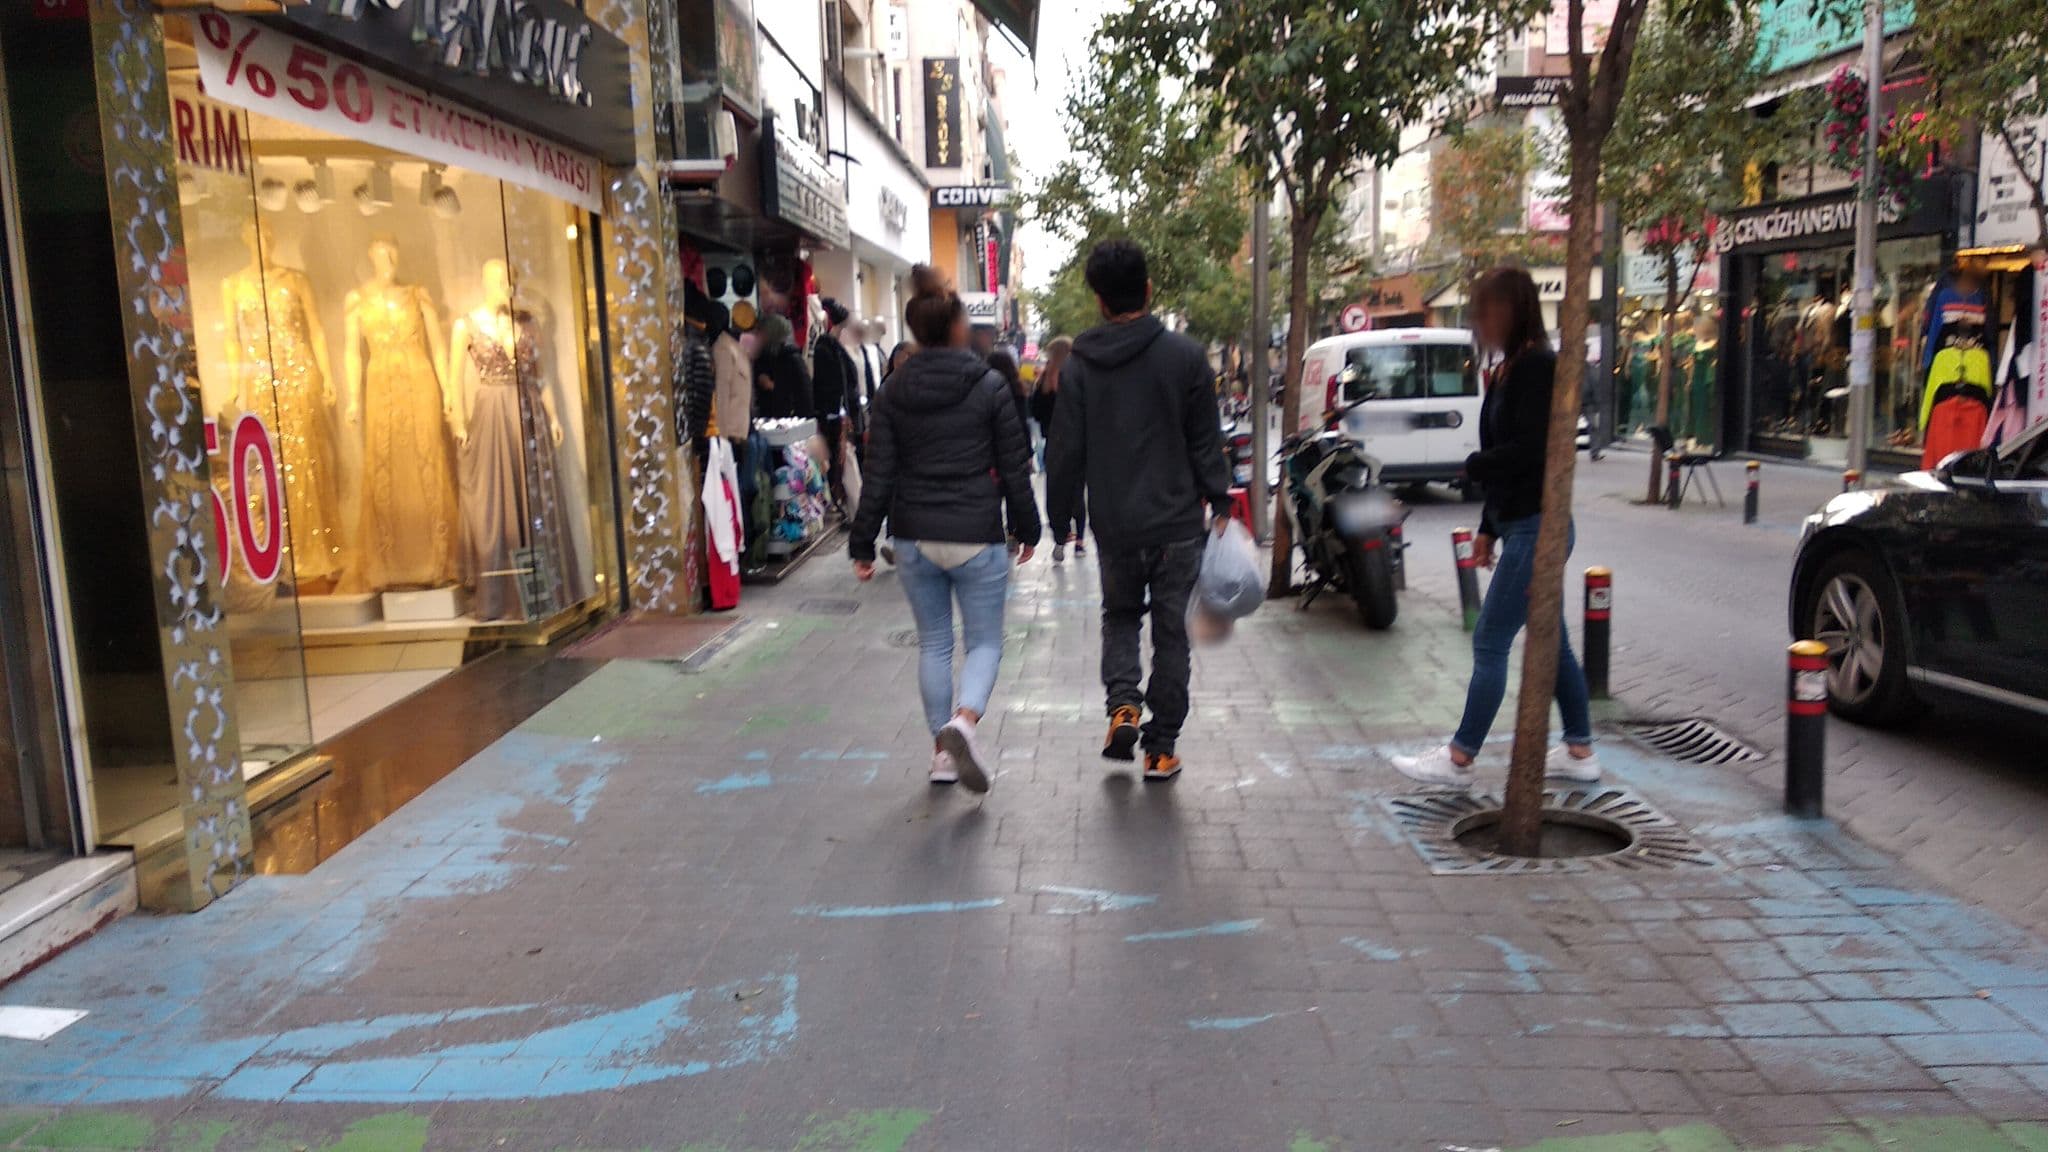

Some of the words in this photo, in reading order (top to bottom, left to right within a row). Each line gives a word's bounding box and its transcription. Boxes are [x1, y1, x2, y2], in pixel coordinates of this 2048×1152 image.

[200, 13, 374, 124] %50
[526, 138, 591, 193] YARISI
[937, 187, 1005, 206] CONVE
